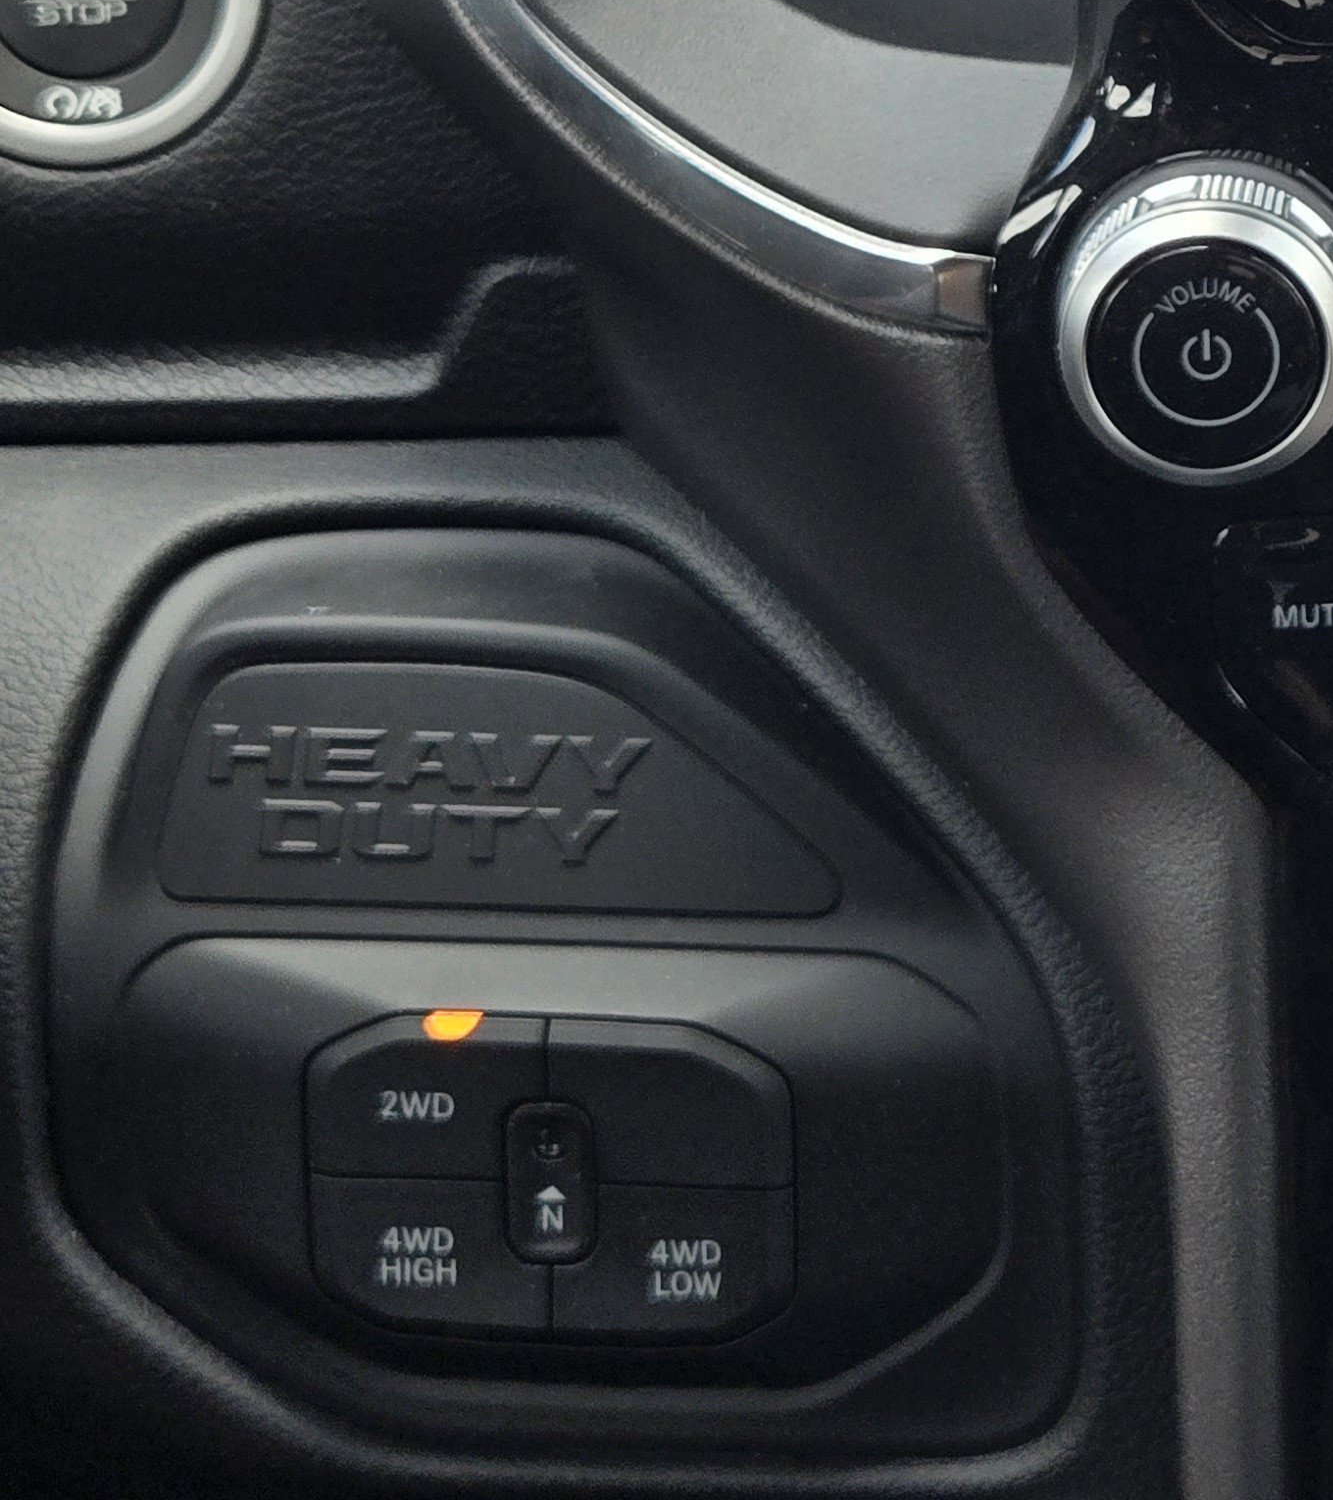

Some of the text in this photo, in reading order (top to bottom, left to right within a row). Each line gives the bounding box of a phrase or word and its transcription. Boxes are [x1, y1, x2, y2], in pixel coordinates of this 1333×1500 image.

[1153, 277, 1256, 315] VOLUME
[206, 721, 653, 794] HEAVY
[258, 797, 619, 866] DUTY
[375, 1090, 455, 1122] 2WD
[541, 1203, 564, 1233] N
[381, 1227, 454, 1255] 4WD
[650, 1240, 722, 1268] 4WD
[378, 1257, 457, 1288] HIGH
[653, 1269, 722, 1300] LOW
